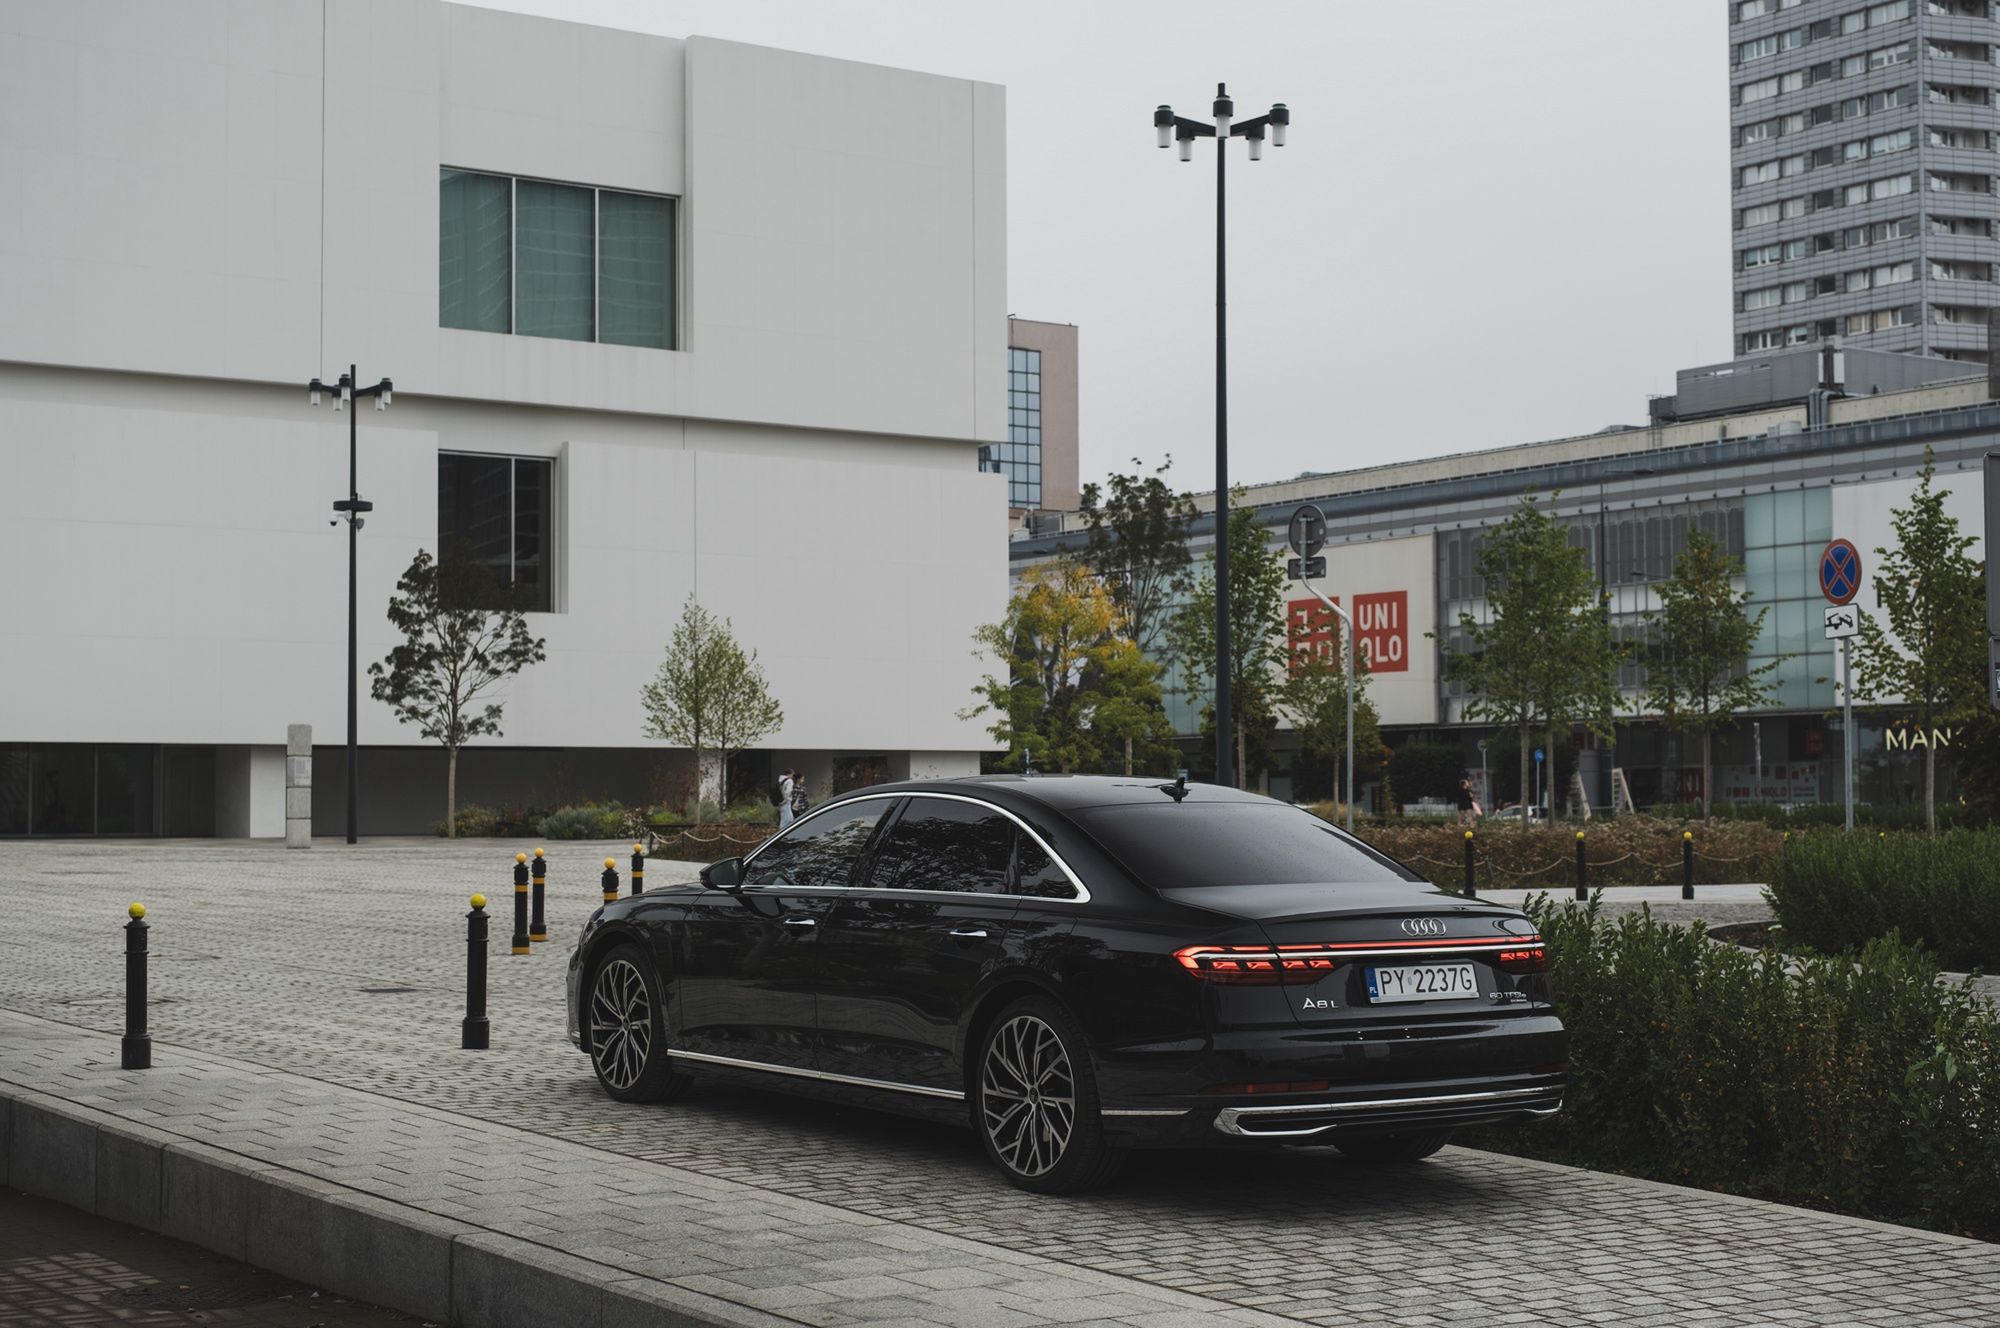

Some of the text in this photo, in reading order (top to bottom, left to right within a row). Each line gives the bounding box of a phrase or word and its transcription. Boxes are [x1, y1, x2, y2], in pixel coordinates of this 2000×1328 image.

[1359, 601, 1398, 630] UNI
[1359, 635, 1402, 668] QLO
[1885, 727, 1963, 751] MAN
[1369, 986, 1378, 994] PL
[1380, 966, 1472, 995] PY 2237G
